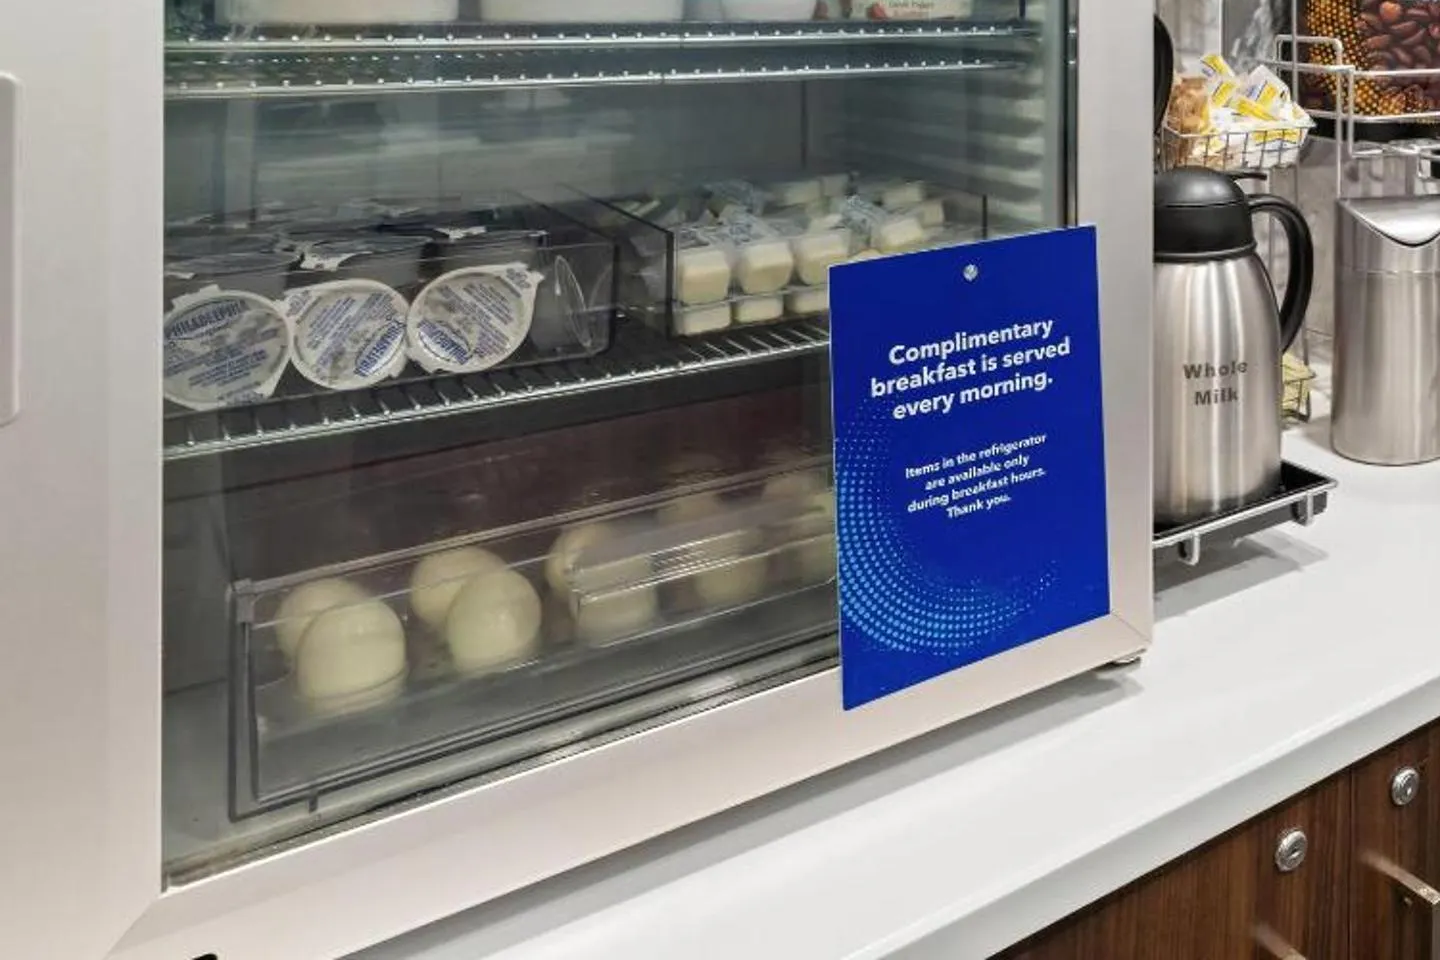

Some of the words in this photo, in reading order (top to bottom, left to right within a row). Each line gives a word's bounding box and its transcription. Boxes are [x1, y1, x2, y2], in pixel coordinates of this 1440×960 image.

[888, 319, 1053, 365] Complimentary
[870, 359, 977, 398] breakfast
[981, 354, 998, 373] is
[1002, 336, 1071, 367] served
[1183, 361, 1248, 380] Whole
[892, 393, 955, 420] every
[959, 371, 1053, 404] morning.
[1194, 387, 1238, 406] Milk
[905, 461, 940, 479] Items
[942, 457, 955, 470] in
[956, 452, 976, 465] the
[979, 433, 1047, 458] refrigerator
[925, 478, 946, 490] are
[948, 461, 1001, 485] available
[1003, 454, 1030, 470] only
[907, 494, 949, 513] during
[951, 475, 1008, 501] breakfast
[1011, 467, 1046, 484] hours.
[946, 500, 984, 519] Thank
[986, 494, 1012, 510] you.
